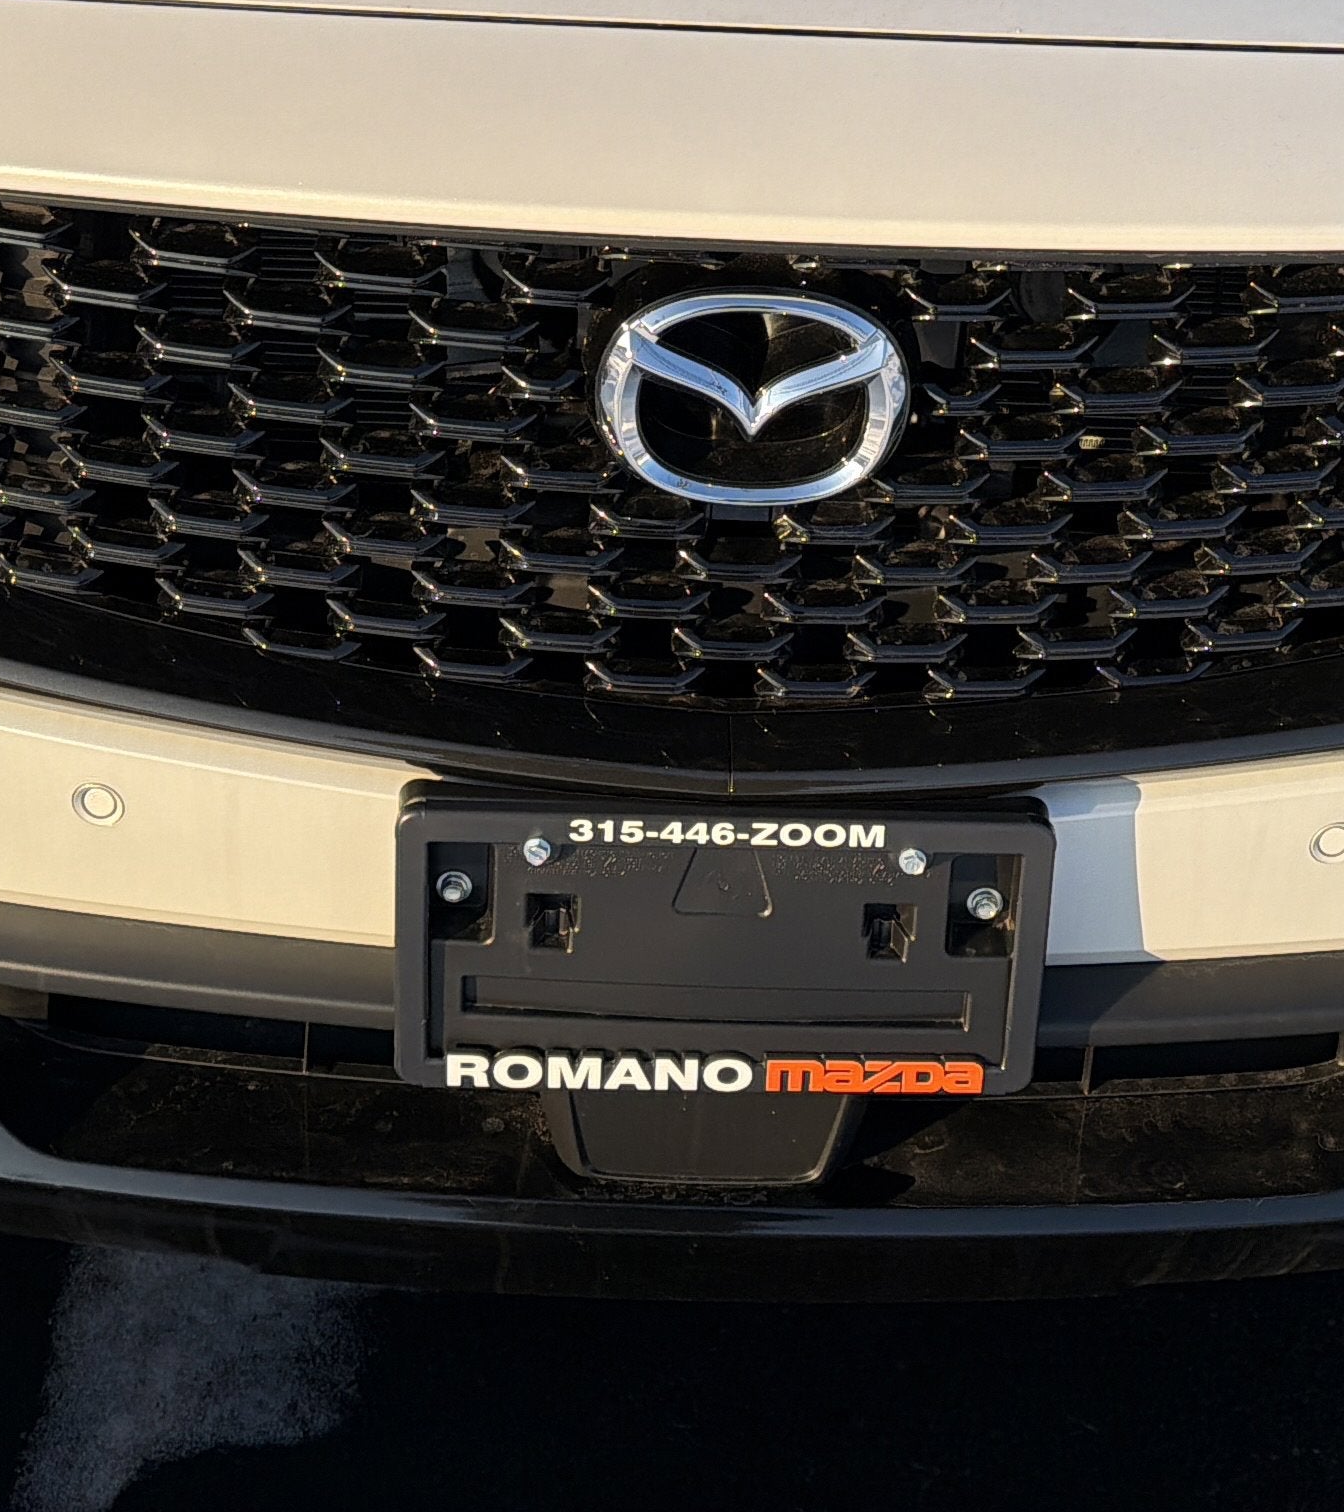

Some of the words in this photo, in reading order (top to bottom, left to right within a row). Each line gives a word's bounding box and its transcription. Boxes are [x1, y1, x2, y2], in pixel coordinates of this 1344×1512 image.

[568, 818, 886, 848] 315-446-ZOOM
[446, 1053, 753, 1093] ROMANO
[765, 1059, 984, 1094] mazda
